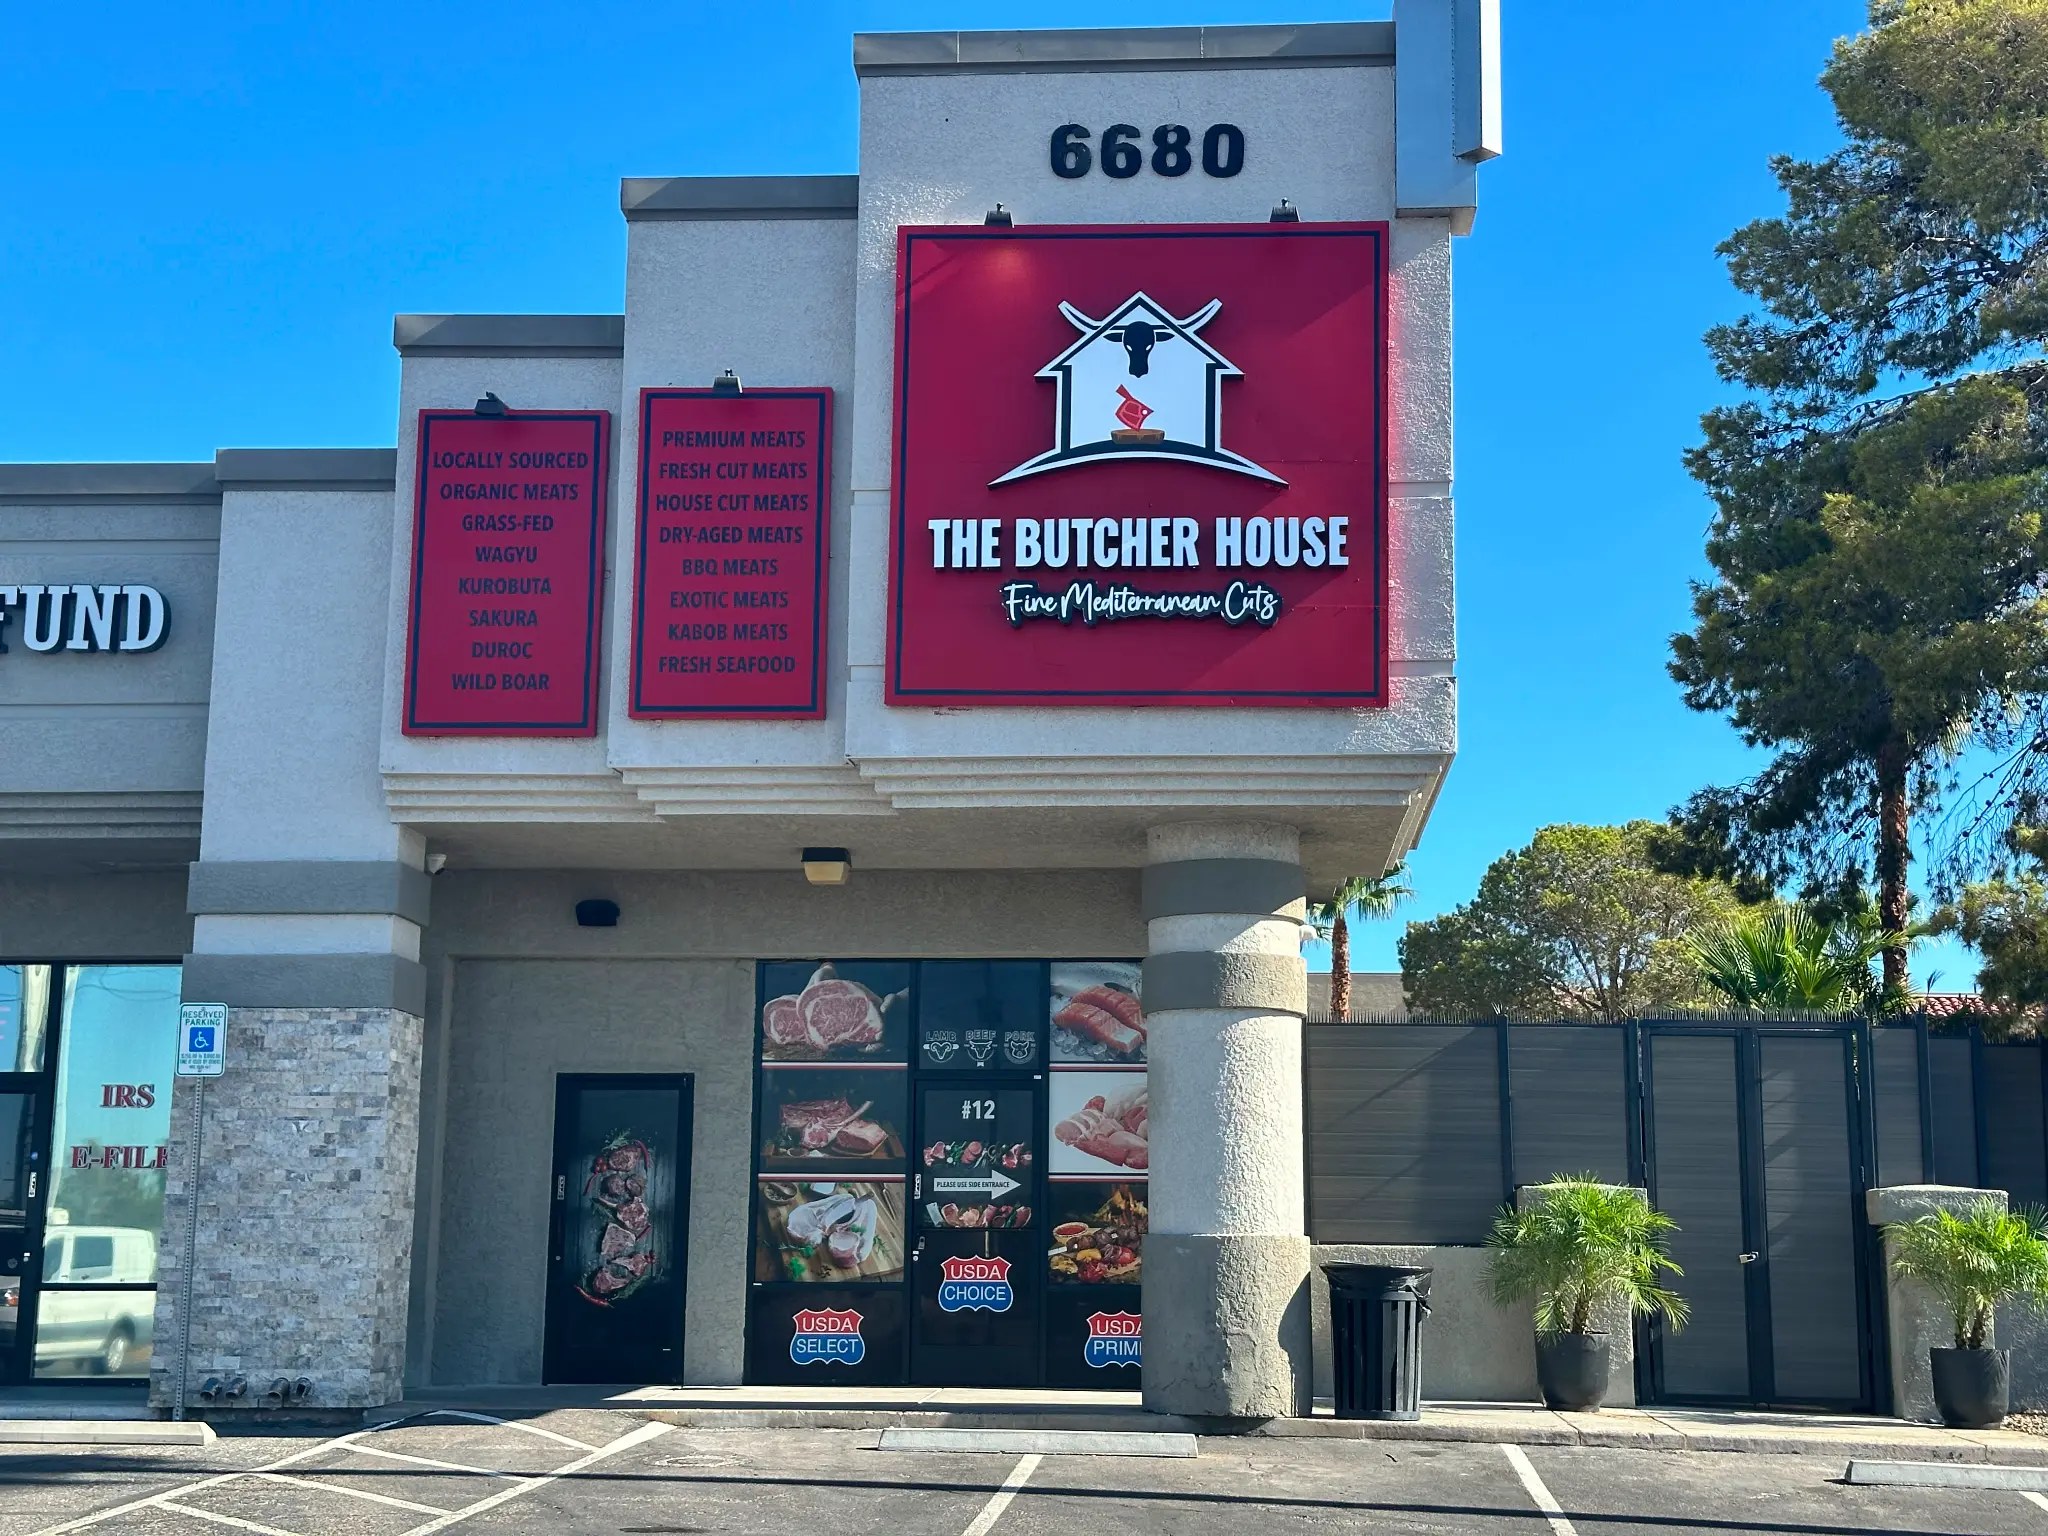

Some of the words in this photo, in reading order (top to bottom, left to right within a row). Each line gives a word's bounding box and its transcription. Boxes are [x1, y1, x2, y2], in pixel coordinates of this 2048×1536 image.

[1050, 123, 1245, 178] 6680
[663, 431, 745, 448] PREMIUM
[751, 431, 806, 448] MEATS
[433, 452, 503, 468] LOCALLY
[509, 452, 588, 468] SOURCED
[659, 463, 711, 479] FRESH
[716, 463, 748, 479] CUT
[752, 463, 808, 479] MEATS
[440, 483, 518, 500] ORGANIC
[523, 483, 579, 500] MEATS
[656, 494, 712, 511] HOUSE
[718, 494, 750, 511] CUT
[753, 494, 808, 511] MEATS
[462, 514, 554, 531] GRASS-FED
[659, 526, 743, 544] DRY-AGED
[748, 526, 803, 543] MEATS
[928, 518, 1002, 568] THE
[1015, 517, 1199, 568] BUTCHER
[1215, 516, 1349, 567] HOUSE
[475, 546, 538, 563] WAGYU
[682, 559, 718, 576] BBQ
[723, 559, 778, 576] MEATS
[458, 577, 552, 595] KUROBUTA
[670, 591, 728, 608] EXOTIC
[733, 591, 789, 608] MEATS
[1004, 583, 1057, 621] Fine
[1061, 581, 1221, 621] Mediterranean
[1224, 581, 1279, 620] Cuts
[468, 609, 538, 627] SAKURA
[668, 624, 728, 641] KABOB
[734, 624, 788, 641] MEATS
[471, 641, 534, 658] DUROC
[659, 656, 712, 673] FRESH
[716, 656, 796, 673] SEAFOOD
[451, 673, 497, 690] WILD
[502, 673, 550, 690] BOAR
[182, 1010, 224, 1019] RESERVED
[185, 1018, 220, 1026] PARKING
[925, 1030, 957, 1042] LAMB
[965, 1029, 997, 1040] BEEF
[1005, 1030, 1035, 1042] PORK
[100, 1084, 155, 1108] IRS
[962, 1100, 995, 1119] #12
[951, 1264, 1001, 1279] USDA
[944, 1286, 1006, 1300] CHOICE
[802, 1317, 854, 1332] USDA
[796, 1338, 859, 1353] SELECT
[1093, 1341, 1141, 1356] PRIM
